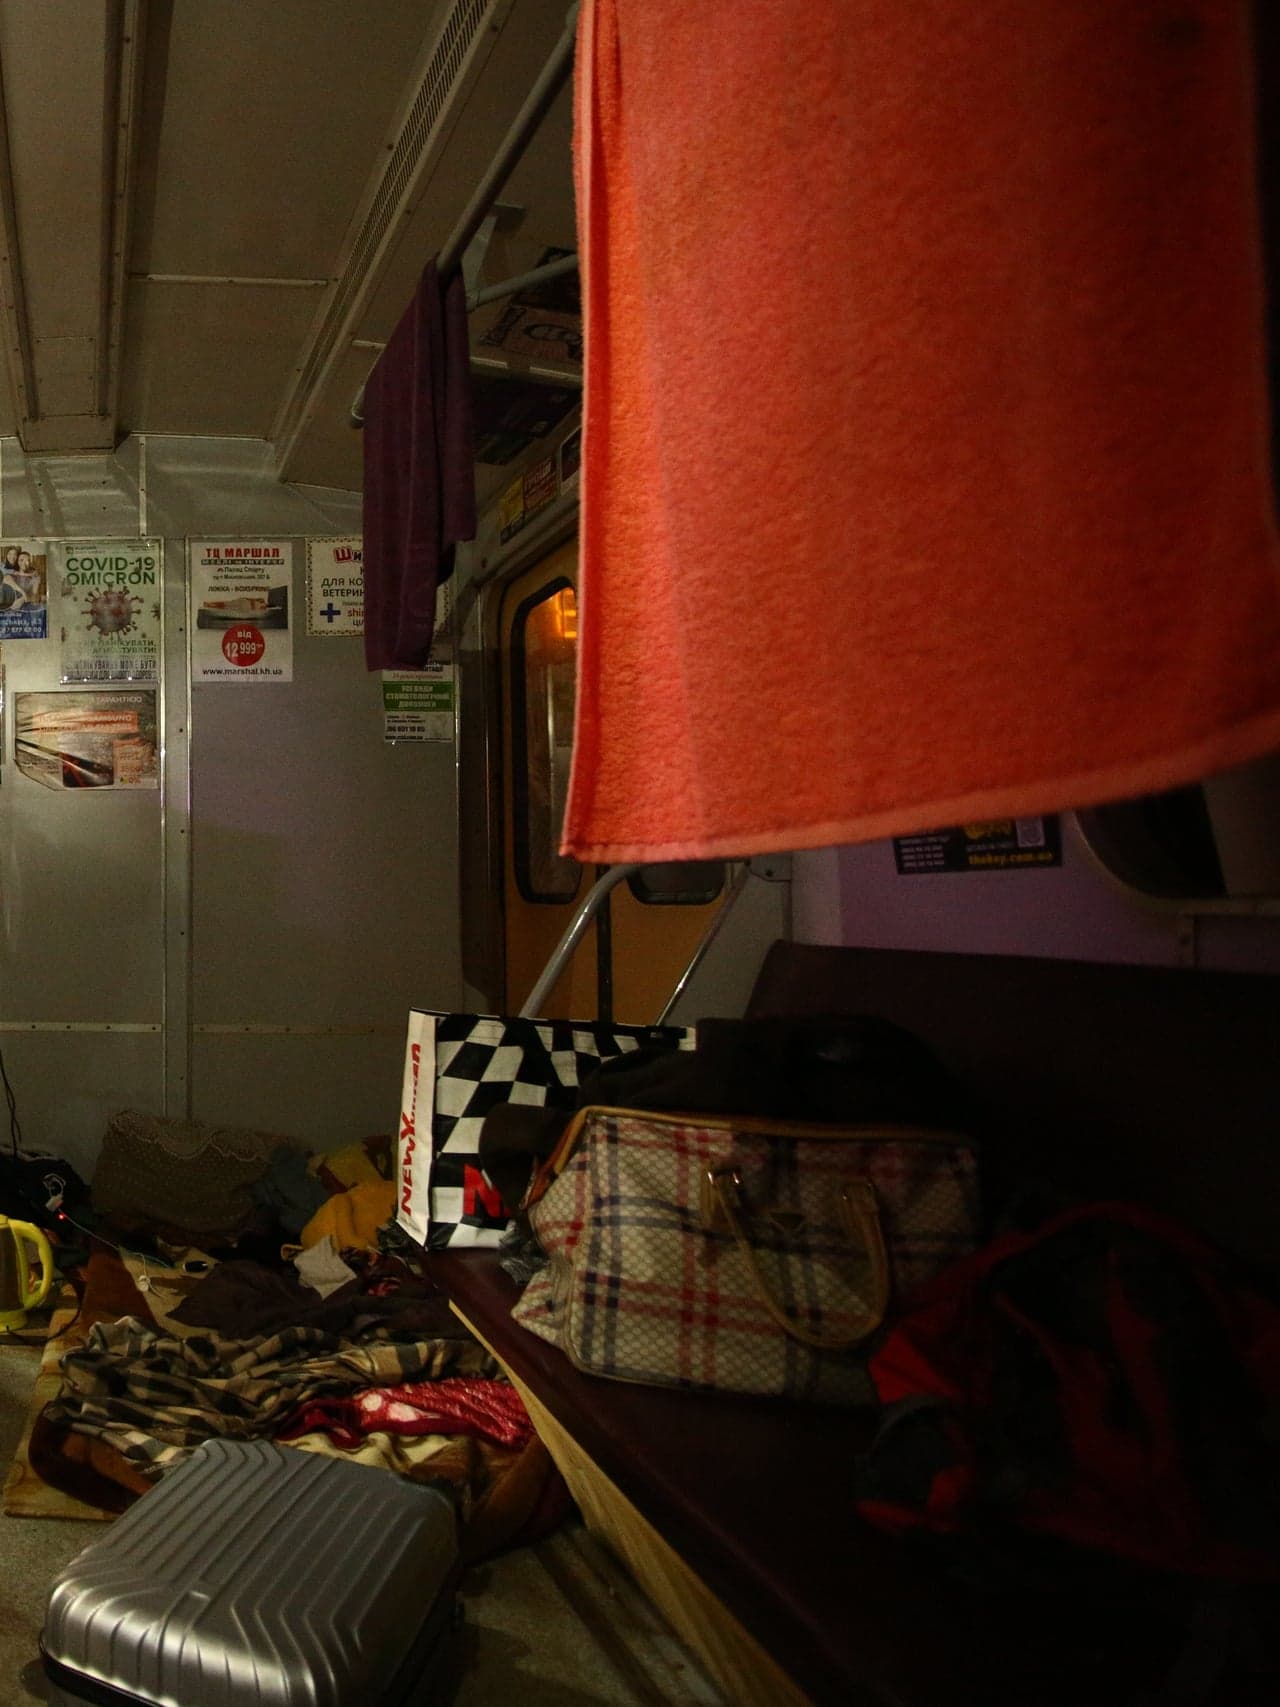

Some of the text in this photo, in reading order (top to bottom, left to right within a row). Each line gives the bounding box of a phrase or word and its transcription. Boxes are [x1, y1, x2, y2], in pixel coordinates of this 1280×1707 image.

[206, 548, 280, 559] ТЦ МАРШАЛ
[66, 557, 155, 571] COVID-19
[66, 572, 155, 585] OMICRON
[321, 577, 364, 588] ДЛЯ КО
[323, 588, 365, 598] ВЕТЕРИН
